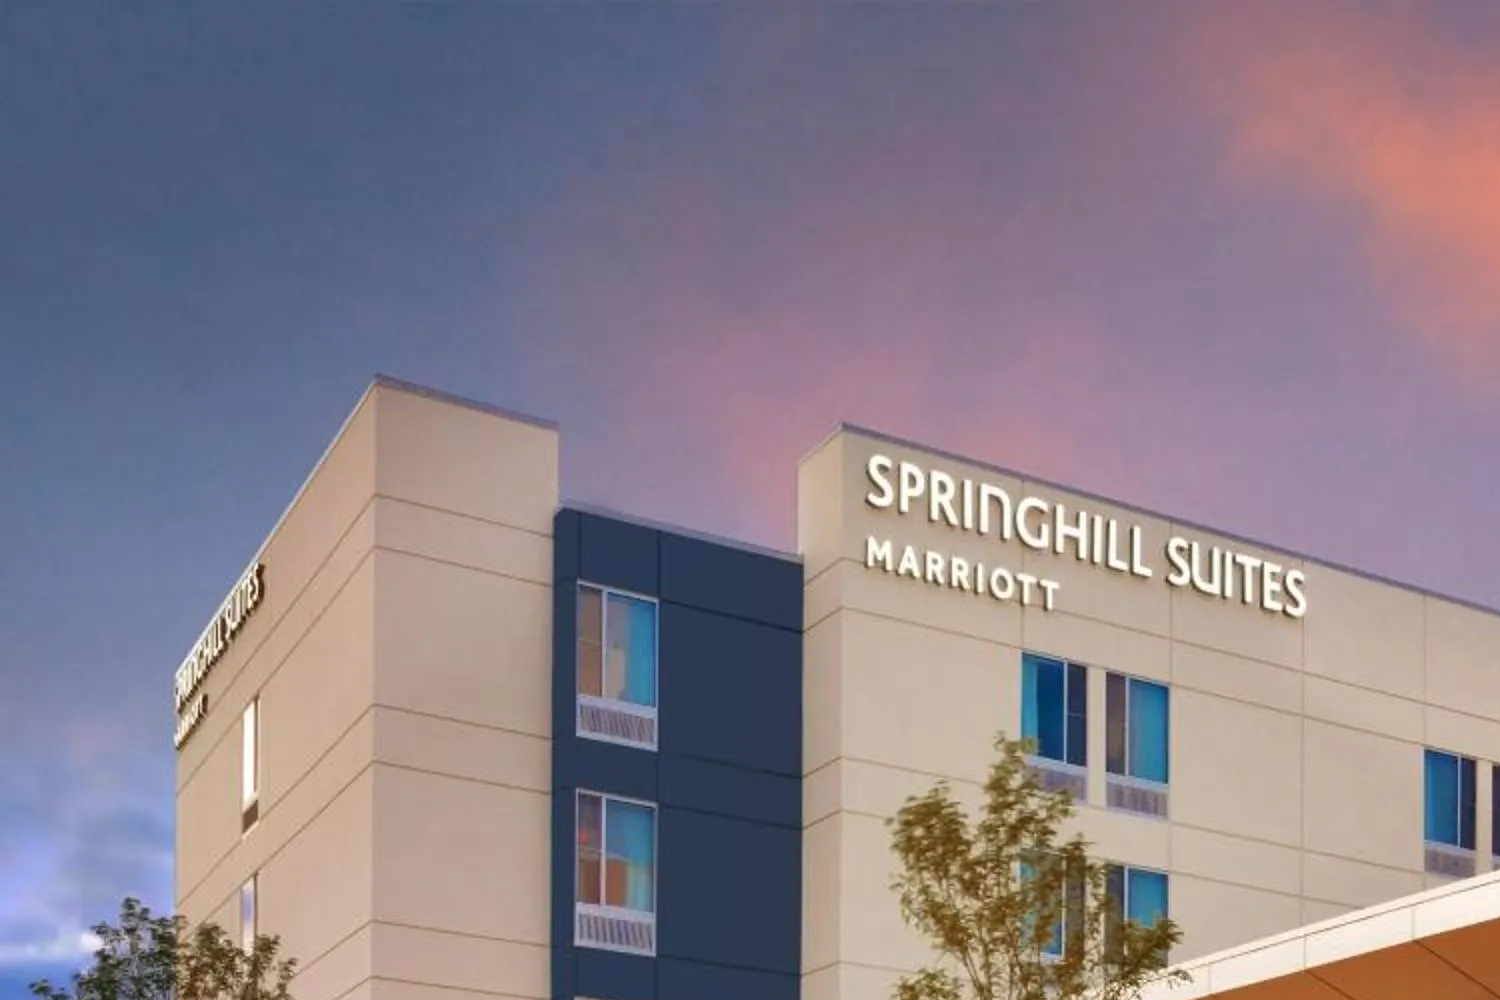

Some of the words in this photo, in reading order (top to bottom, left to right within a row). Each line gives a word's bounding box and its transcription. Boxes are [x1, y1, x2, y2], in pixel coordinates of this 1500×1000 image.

[866, 454, 1154, 579] SPRINGHILL
[1165, 535, 1308, 618] SUITES
[866, 535, 1061, 611] MARRIOTT
